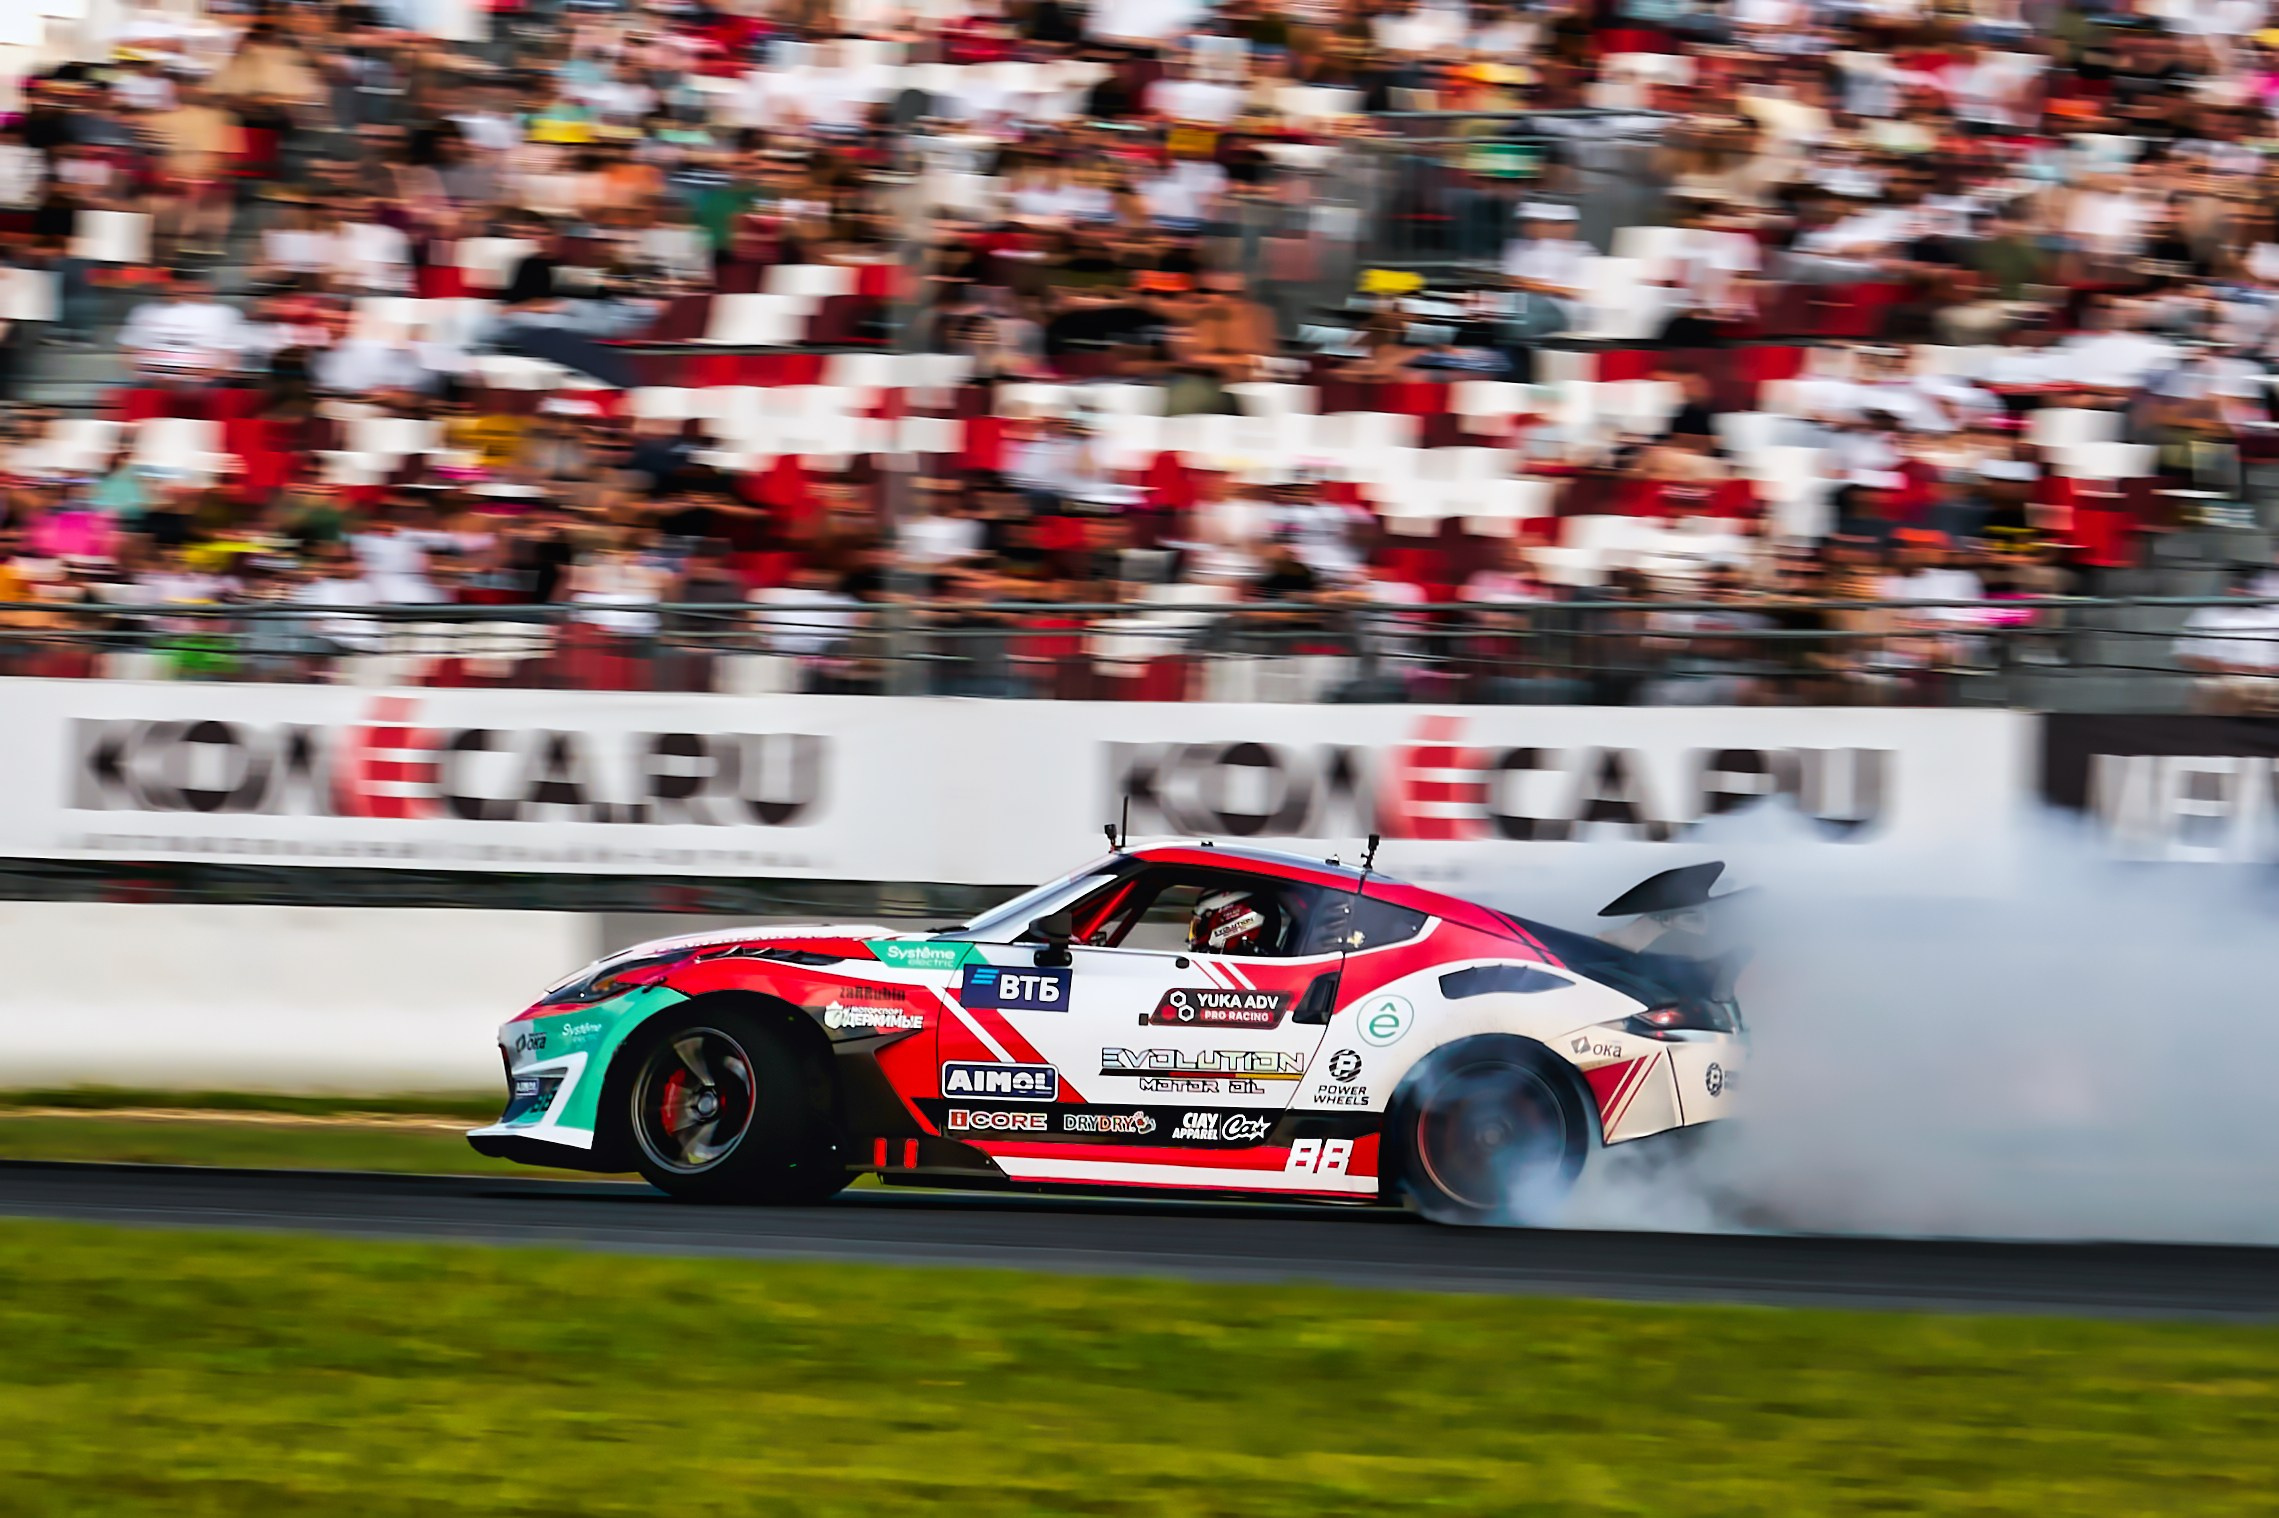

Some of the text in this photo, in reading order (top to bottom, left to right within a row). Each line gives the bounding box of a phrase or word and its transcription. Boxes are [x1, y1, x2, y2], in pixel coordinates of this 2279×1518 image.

[999, 974, 1060, 1002] ВТБ
[1197, 993, 1279, 1009] YUKA ADV
[1204, 1010, 1269, 1022] PRO RACING
[1102, 1048, 1304, 1073] EVOLUTION
[947, 1069, 1053, 1094] AIMOL
[1139, 1078, 1265, 1094] MOTOR OIL
[1318, 1085, 1367, 1095] POWER
[1314, 1095, 1369, 1106] WHEELS
[1171, 1127, 1218, 1140] APPAREL
[1284, 1139, 1354, 1175] 88
